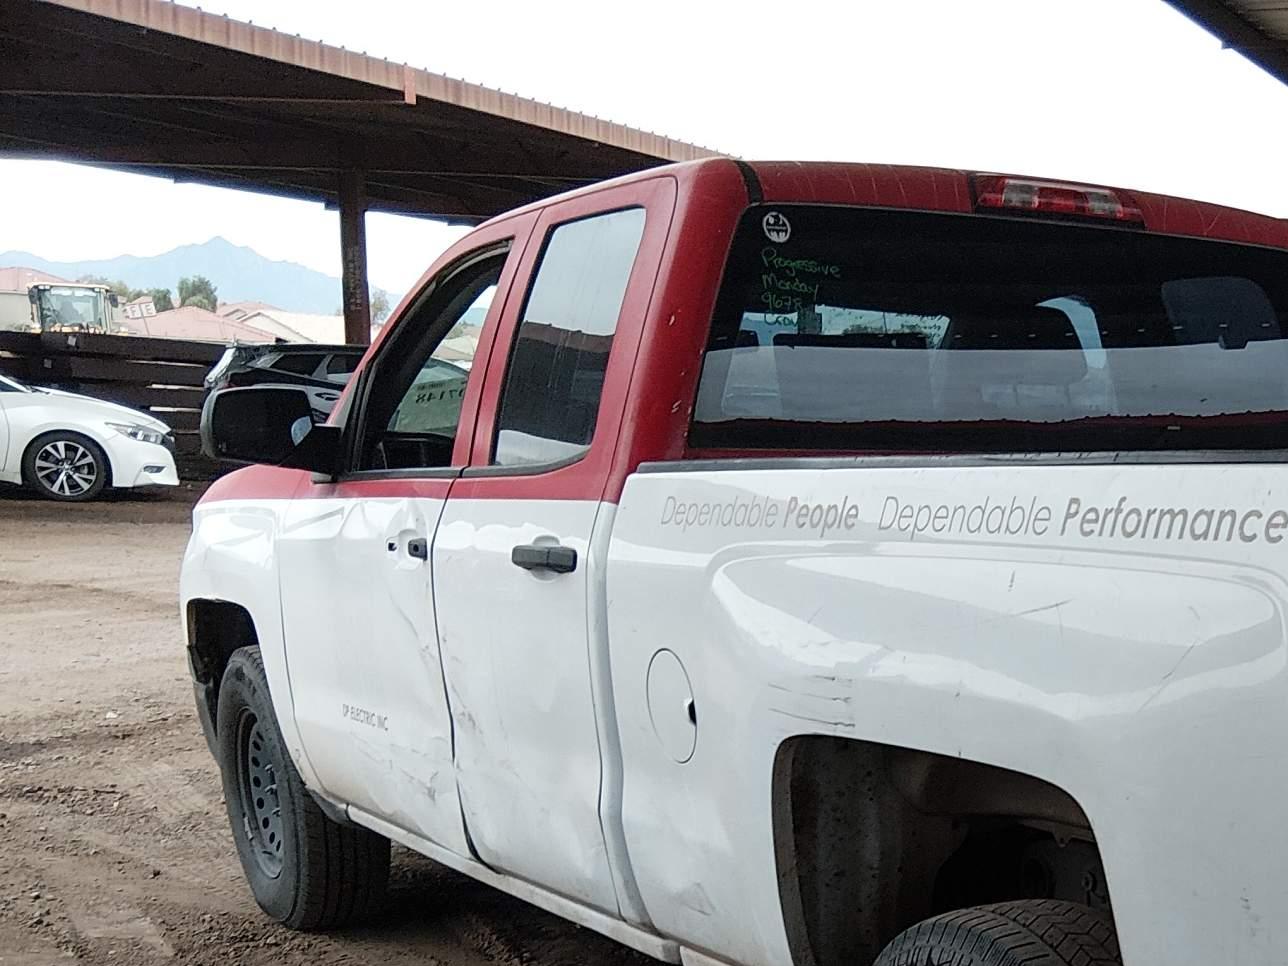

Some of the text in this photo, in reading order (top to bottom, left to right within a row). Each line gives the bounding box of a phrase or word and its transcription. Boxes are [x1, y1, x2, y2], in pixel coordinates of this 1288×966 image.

[661, 495, 778, 533] Dependable
[782, 496, 859, 538] People
[878, 496, 1052, 541] Dependable
